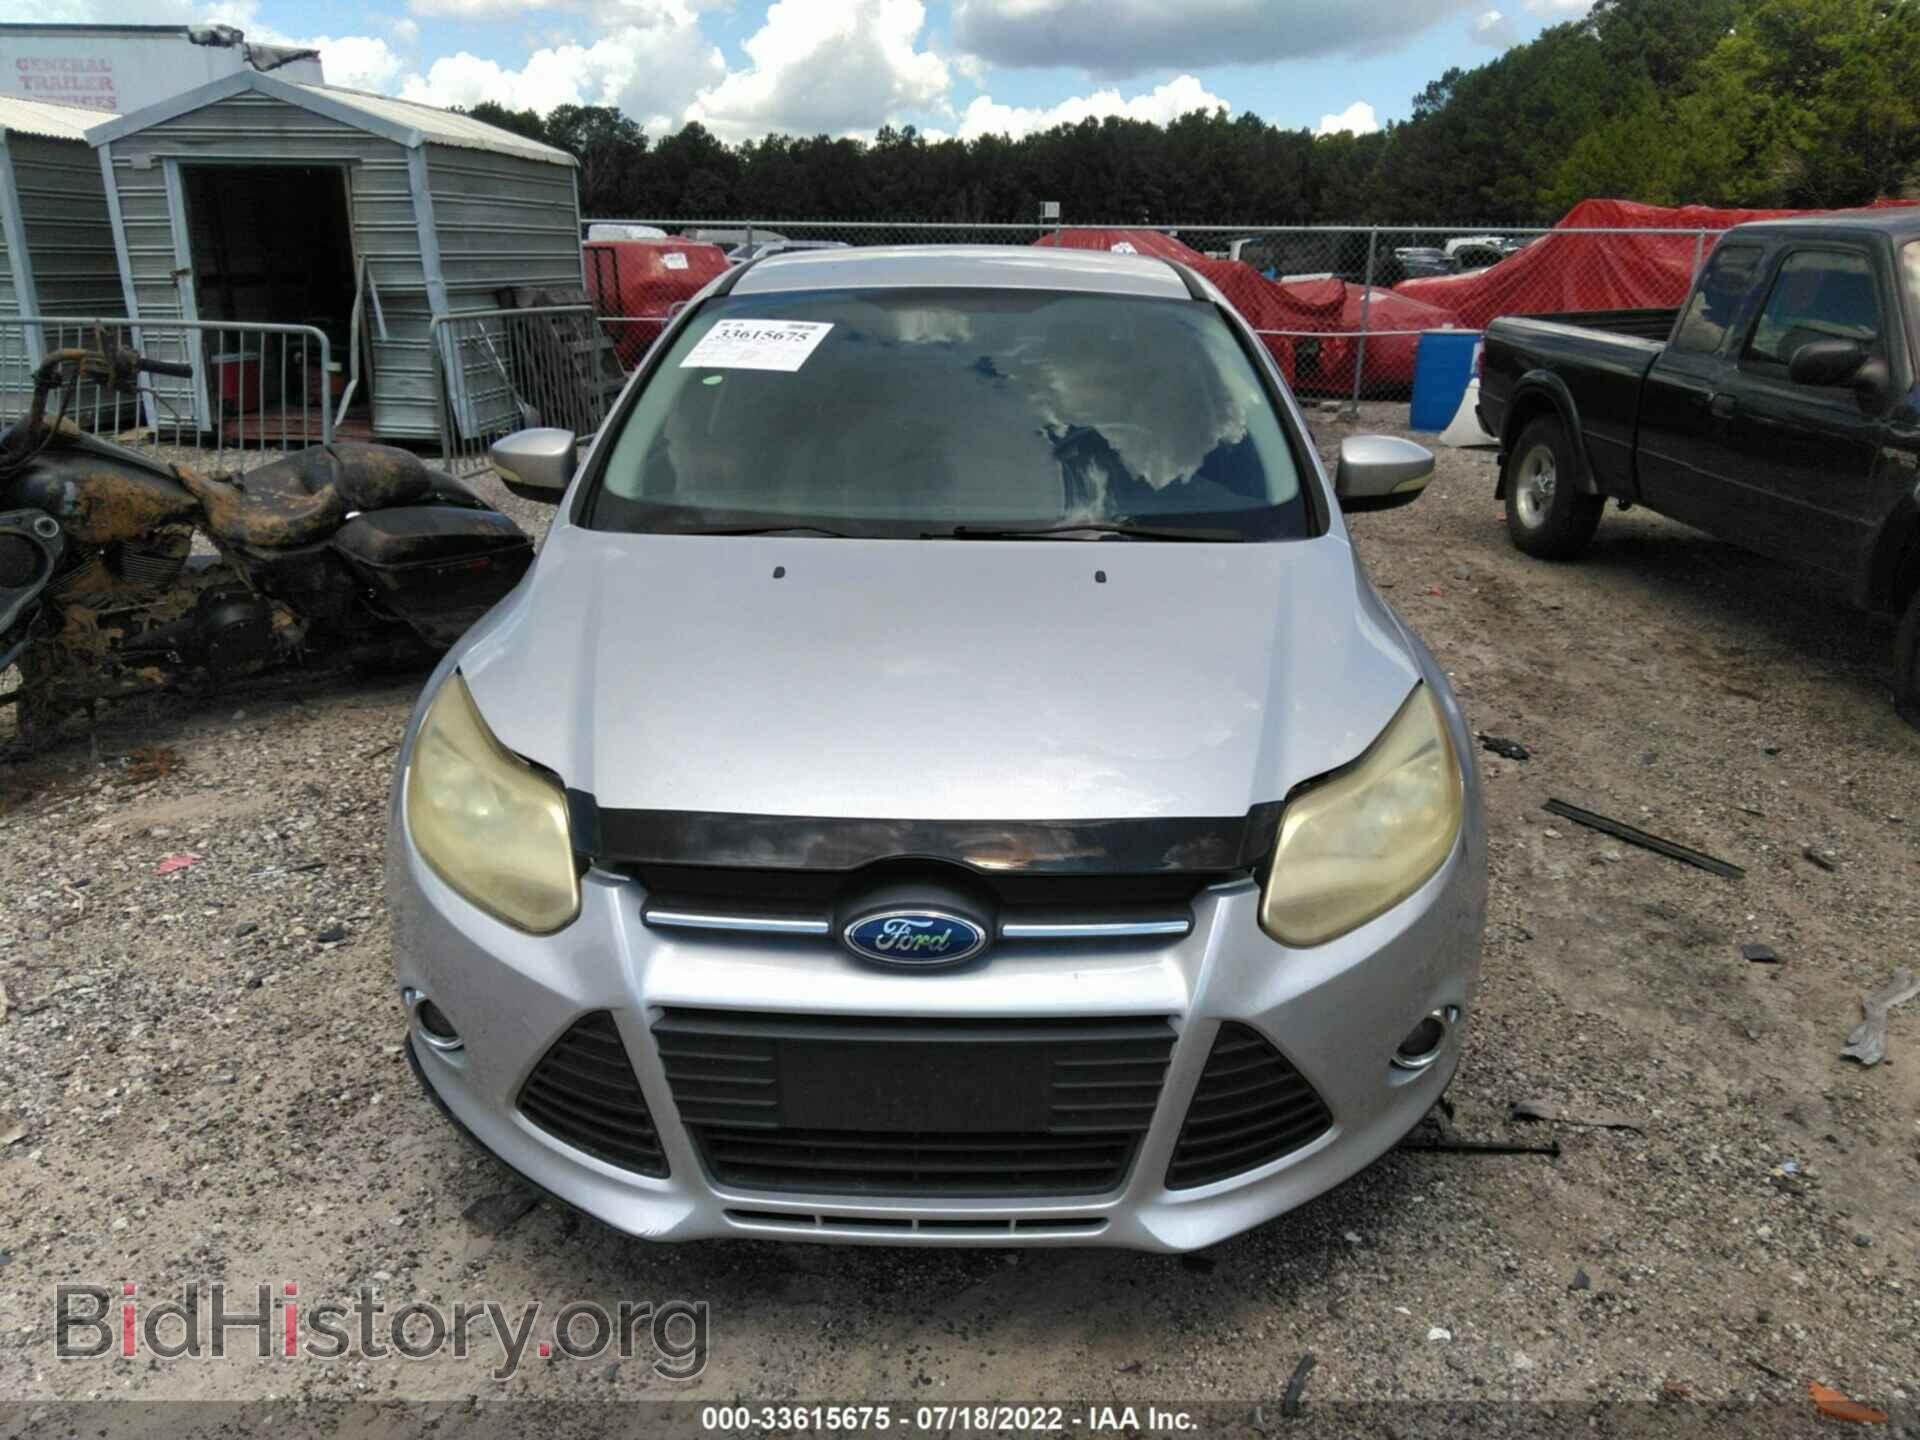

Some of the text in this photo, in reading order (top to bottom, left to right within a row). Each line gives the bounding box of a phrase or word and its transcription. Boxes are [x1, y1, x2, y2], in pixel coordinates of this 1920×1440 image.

[15, 57, 112, 73] GENERAL
[19, 75, 114, 91] TRAILER
[721, 329, 810, 342] 33615675
[875, 918, 953, 951] Ford
